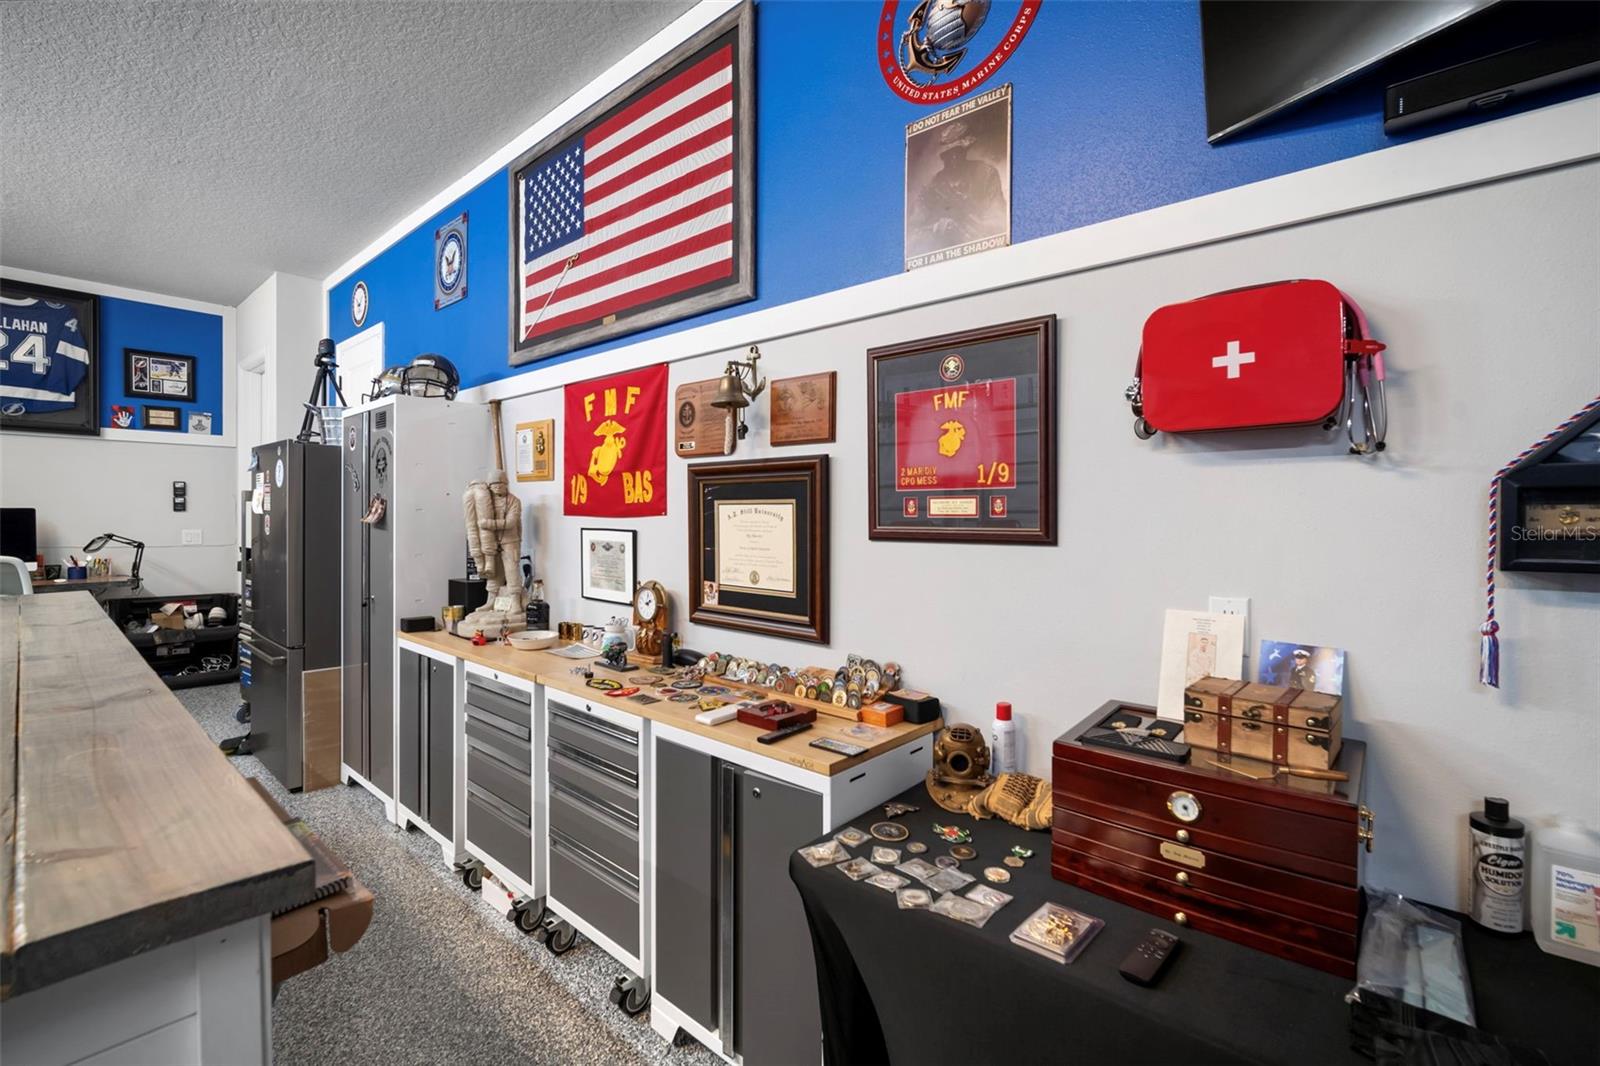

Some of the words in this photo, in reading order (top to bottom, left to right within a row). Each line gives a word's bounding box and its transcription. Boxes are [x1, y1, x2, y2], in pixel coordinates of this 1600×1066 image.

[892, 75, 920, 99] UNITED
[921, 86, 959, 101] STATES
[961, 53, 1004, 91] MARINE
[1003, 7, 1032, 51] CORPS
[913, 122, 924, 133] DO
[924, 115, 941, 129] NOT
[941, 107, 960, 121] FEAR
[961, 101, 977, 114] THE
[977, 87, 1007, 106] VALLEY
[907, 259, 923, 269] FOR
[929, 251, 945, 264] AM
[945, 246, 962, 260] THE
[963, 237, 1005, 255] SHADOW
[0, 316, 48, 333] LAHAN
[0, 330, 51, 375] 4
[933, 390, 968, 411] FMF
[901, 476, 916, 486] CPO
[916, 475, 938, 486] MESS
[977, 462, 1010, 485] 1/9
[571, 474, 588, 506] 1/9
[622, 470, 653, 504] BAS
[1487, 855, 1520, 868] Cigar
